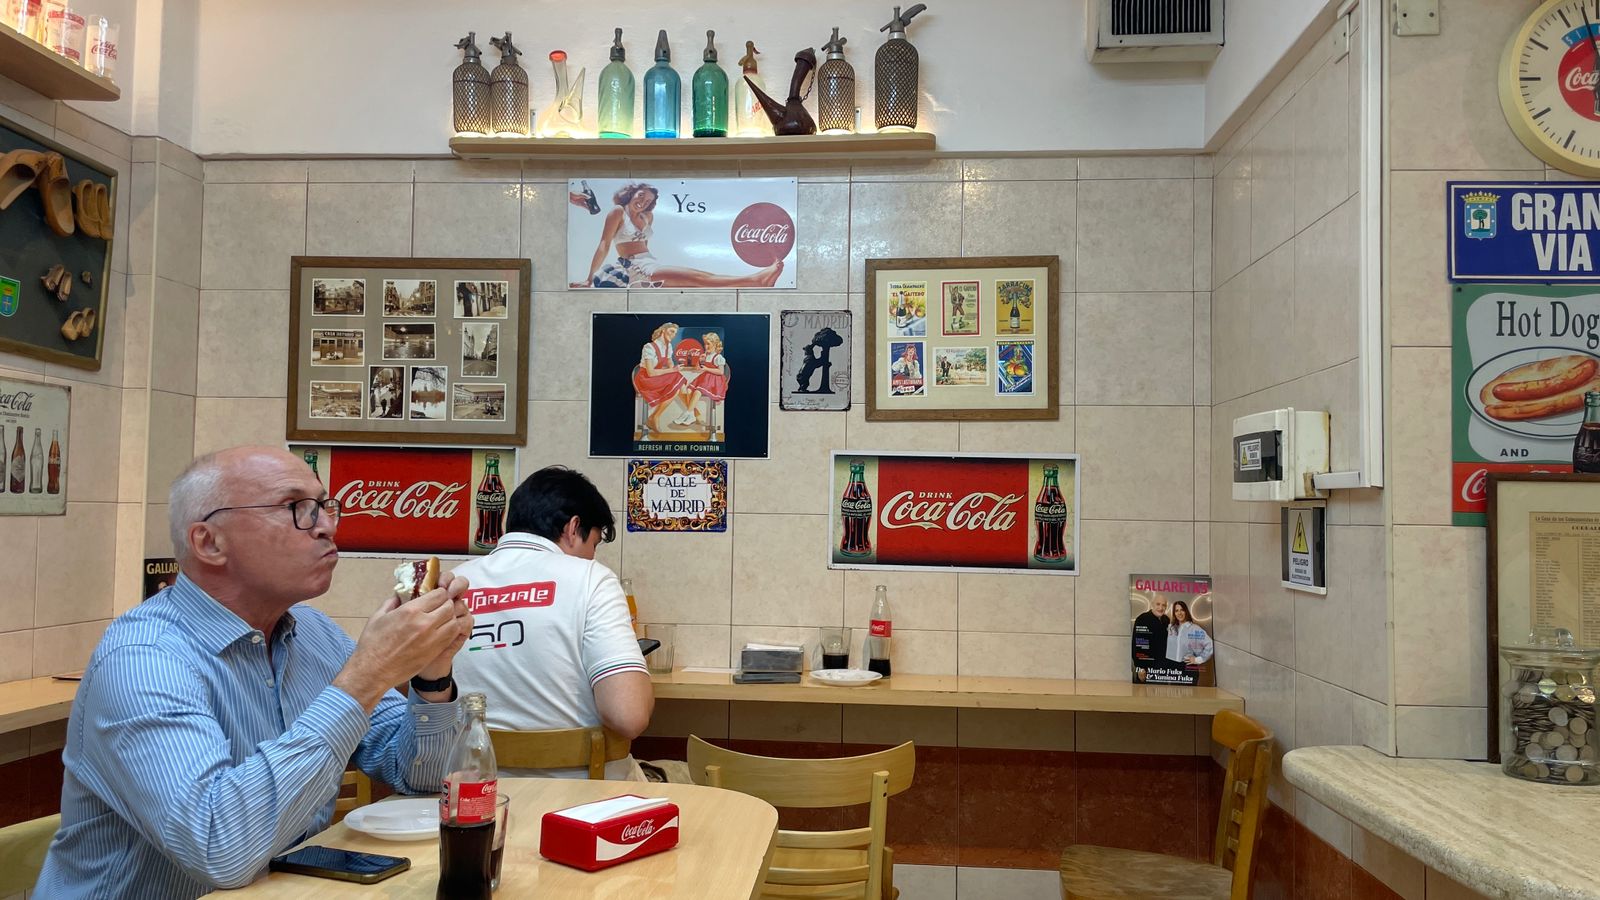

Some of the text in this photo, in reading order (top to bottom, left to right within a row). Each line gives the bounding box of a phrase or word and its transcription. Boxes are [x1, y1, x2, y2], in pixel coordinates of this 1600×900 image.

[672, 193, 706, 213] Yes
[1511, 192, 1600, 231] GRAN
[734, 223, 789, 244] Coca-Cola
[1531, 233, 1593, 271] VIA
[1496, 301, 1600, 350] Hot Dog
[639, 444, 720, 452] REFRESH AT OUR FOUNTAIN
[1500, 448, 1529, 457] AND
[368, 480, 400, 488] DRINK
[657, 477, 697, 487] CALLE
[670, 489, 685, 498] DE
[919, 491, 953, 499] DRINK
[651, 499, 705, 514] MADRID
[880, 490, 1026, 531] Coca-Cola
[1135, 579, 1209, 594] GALLARETAS
[621, 818, 655, 842] Coca-Cola
